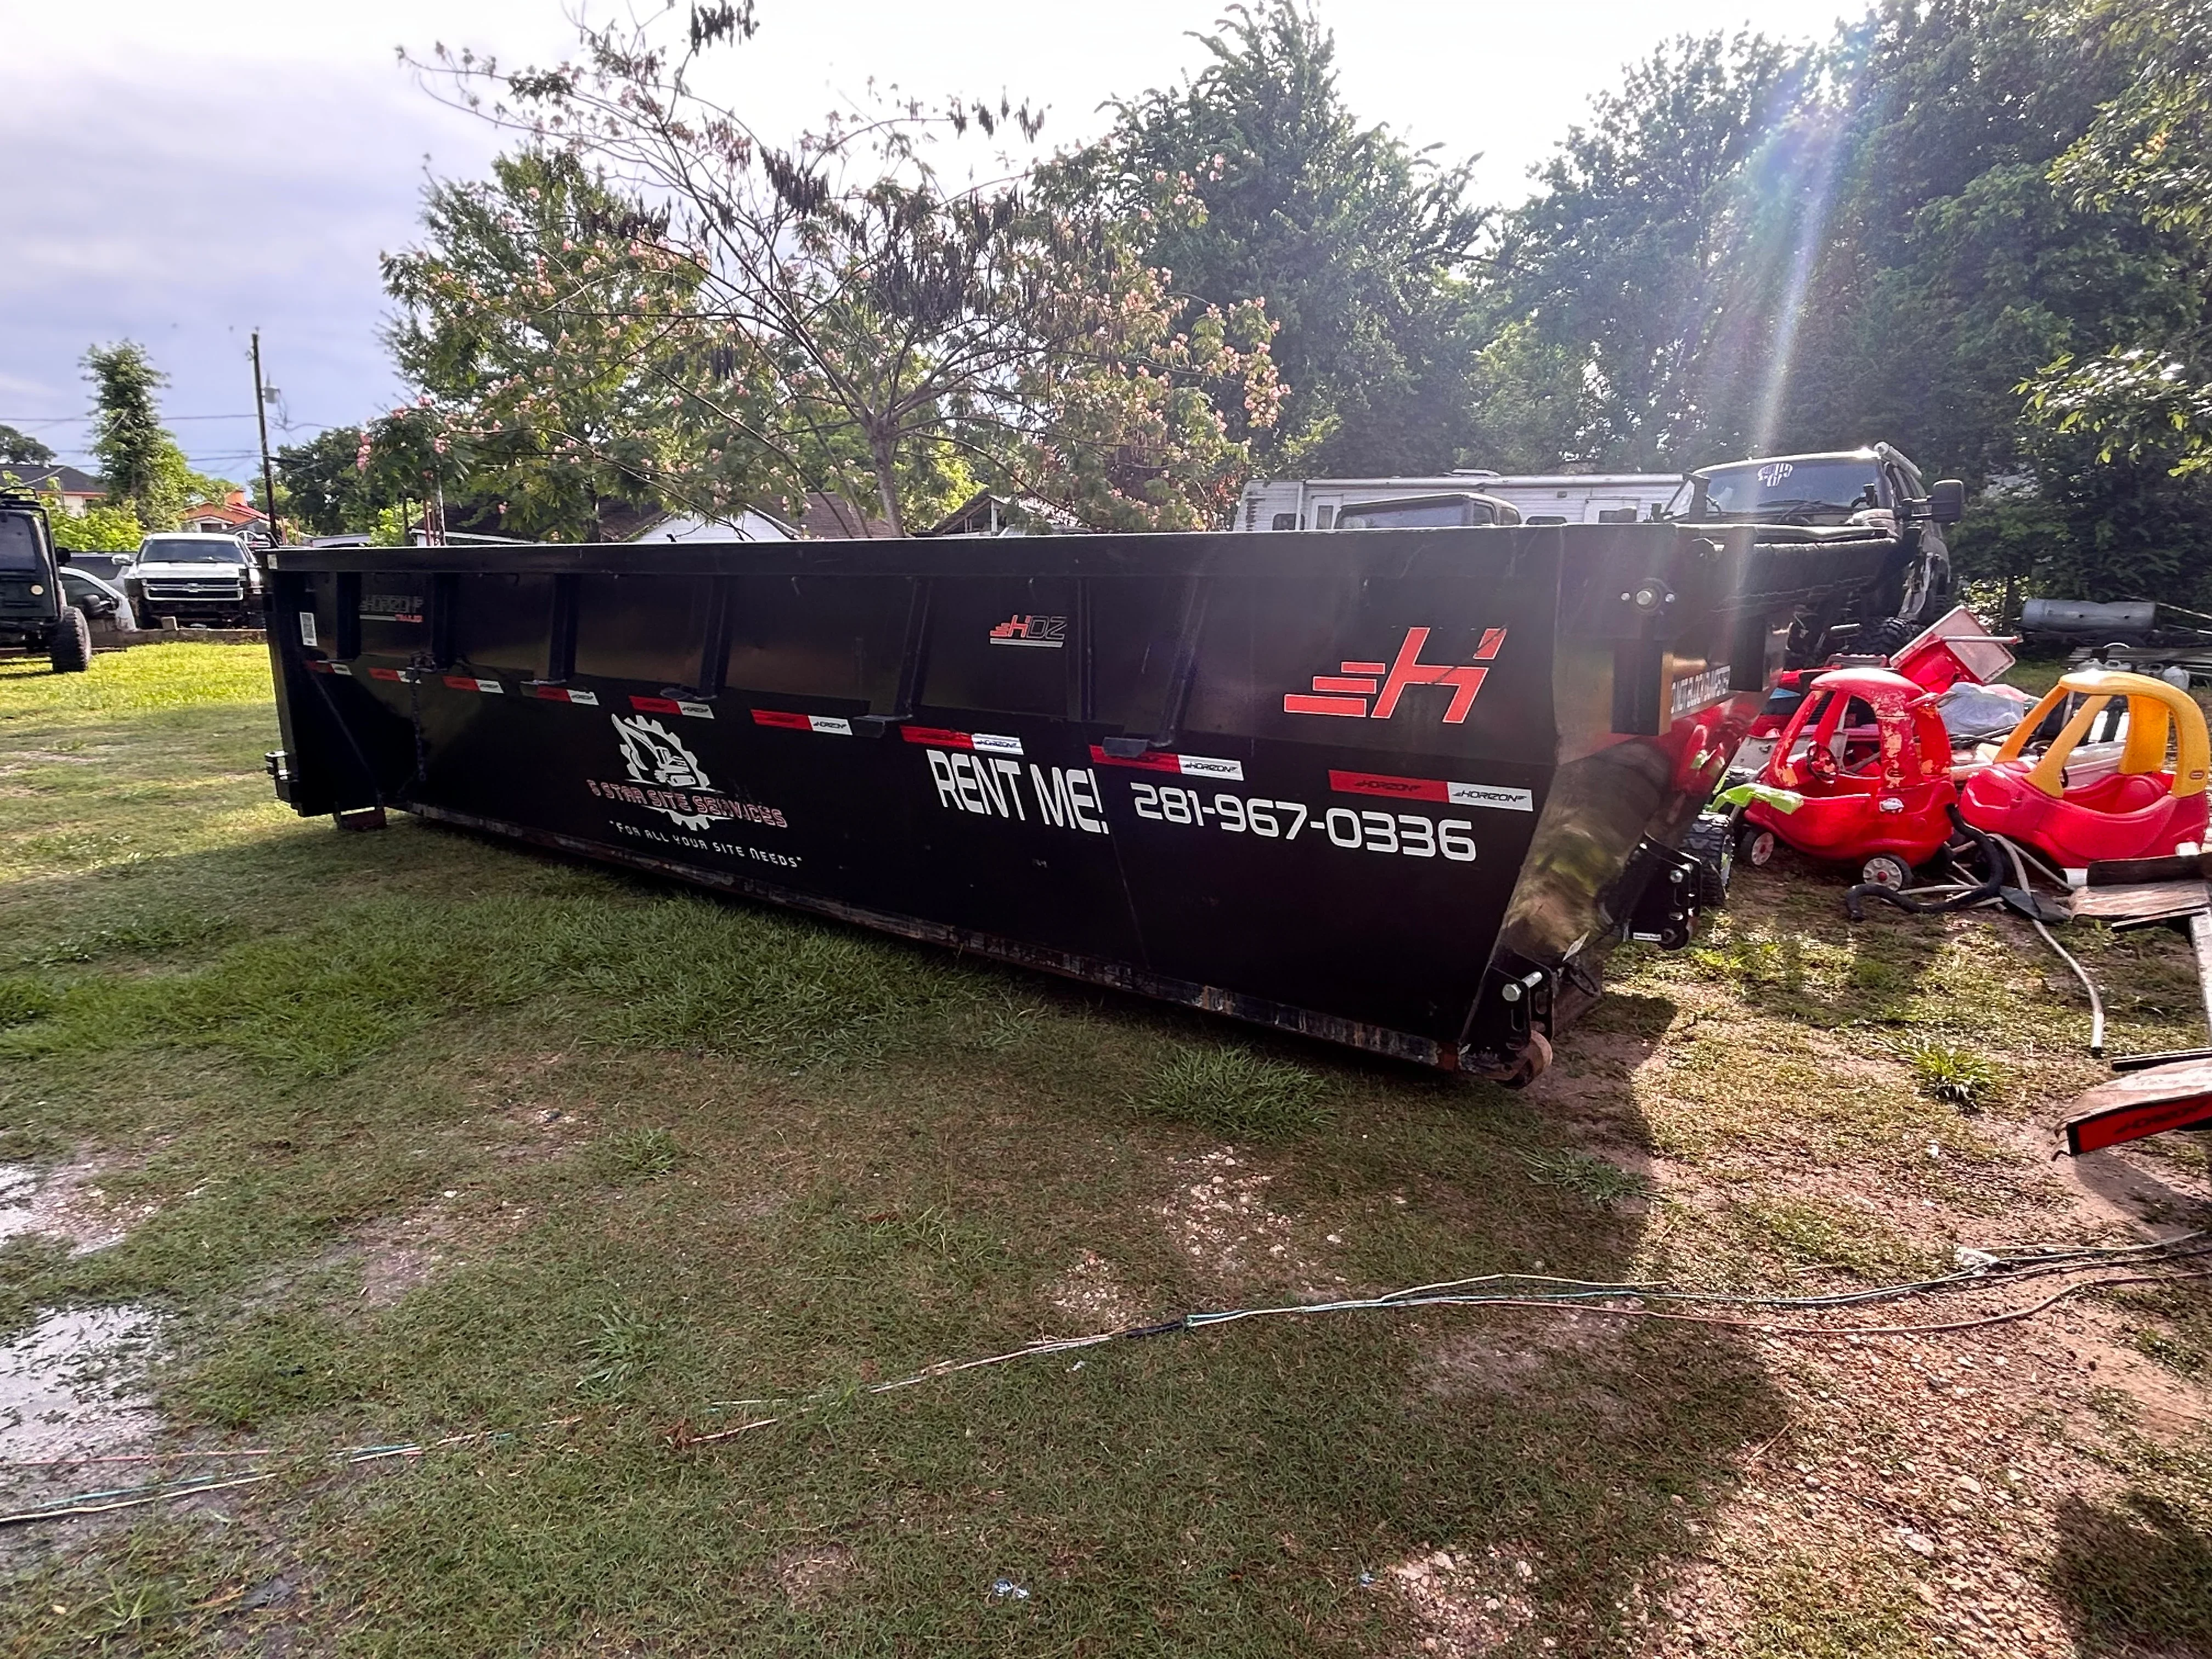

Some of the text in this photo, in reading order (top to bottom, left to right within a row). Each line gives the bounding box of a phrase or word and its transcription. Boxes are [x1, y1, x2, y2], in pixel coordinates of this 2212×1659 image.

[1186, 762, 1238, 772] HORIZON
[600, 782, 648, 805] STAR
[646, 789, 692, 812] SITE
[692, 795, 788, 828] SERVICES
[926, 749, 1110, 834] RENT ME!
[1457, 789, 1527, 803] HORIZON
[1130, 782, 1477, 862] 281-967-0336
[644, 829, 670, 843] ALL
[672, 834, 708, 850] YOUR
[712, 842, 746, 857] SITE
